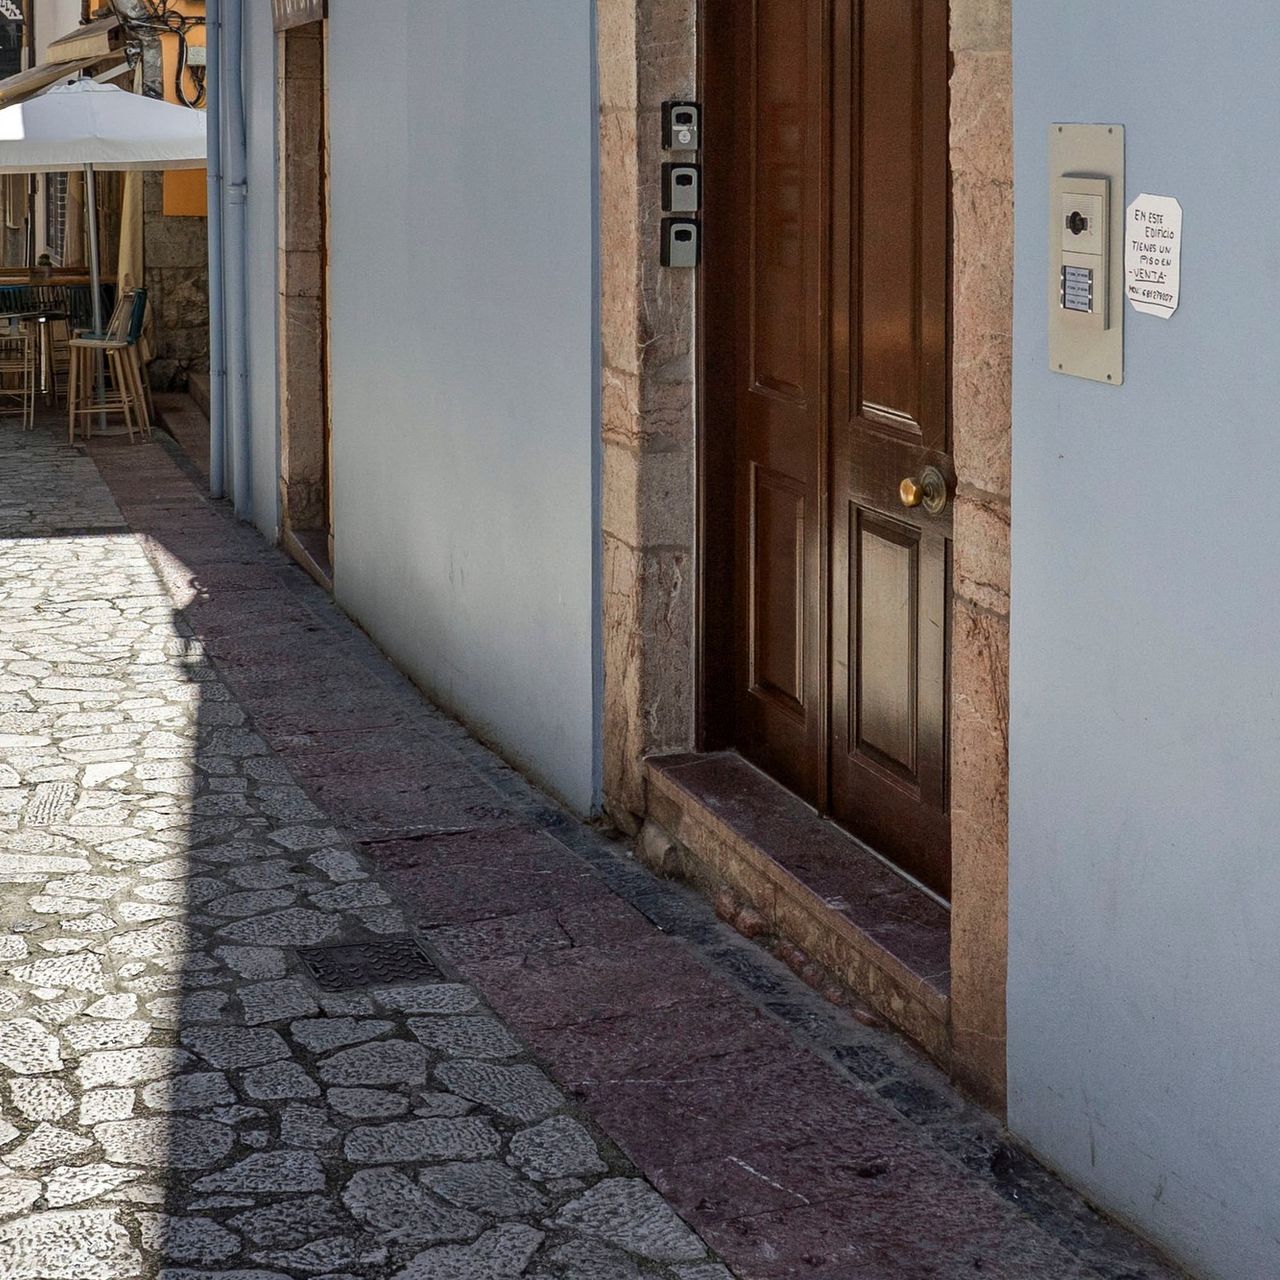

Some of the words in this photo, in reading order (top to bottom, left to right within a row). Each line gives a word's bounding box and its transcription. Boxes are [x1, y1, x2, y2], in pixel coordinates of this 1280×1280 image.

[1134, 209, 1146, 221] EN
[1148, 211, 1164, 224] ESTE
[1132, 240, 1157, 253] TIENES
[1159, 246, 1172, 254] UN
[1140, 254, 1160, 266] PISO
[1161, 257, 1172, 266] EN
